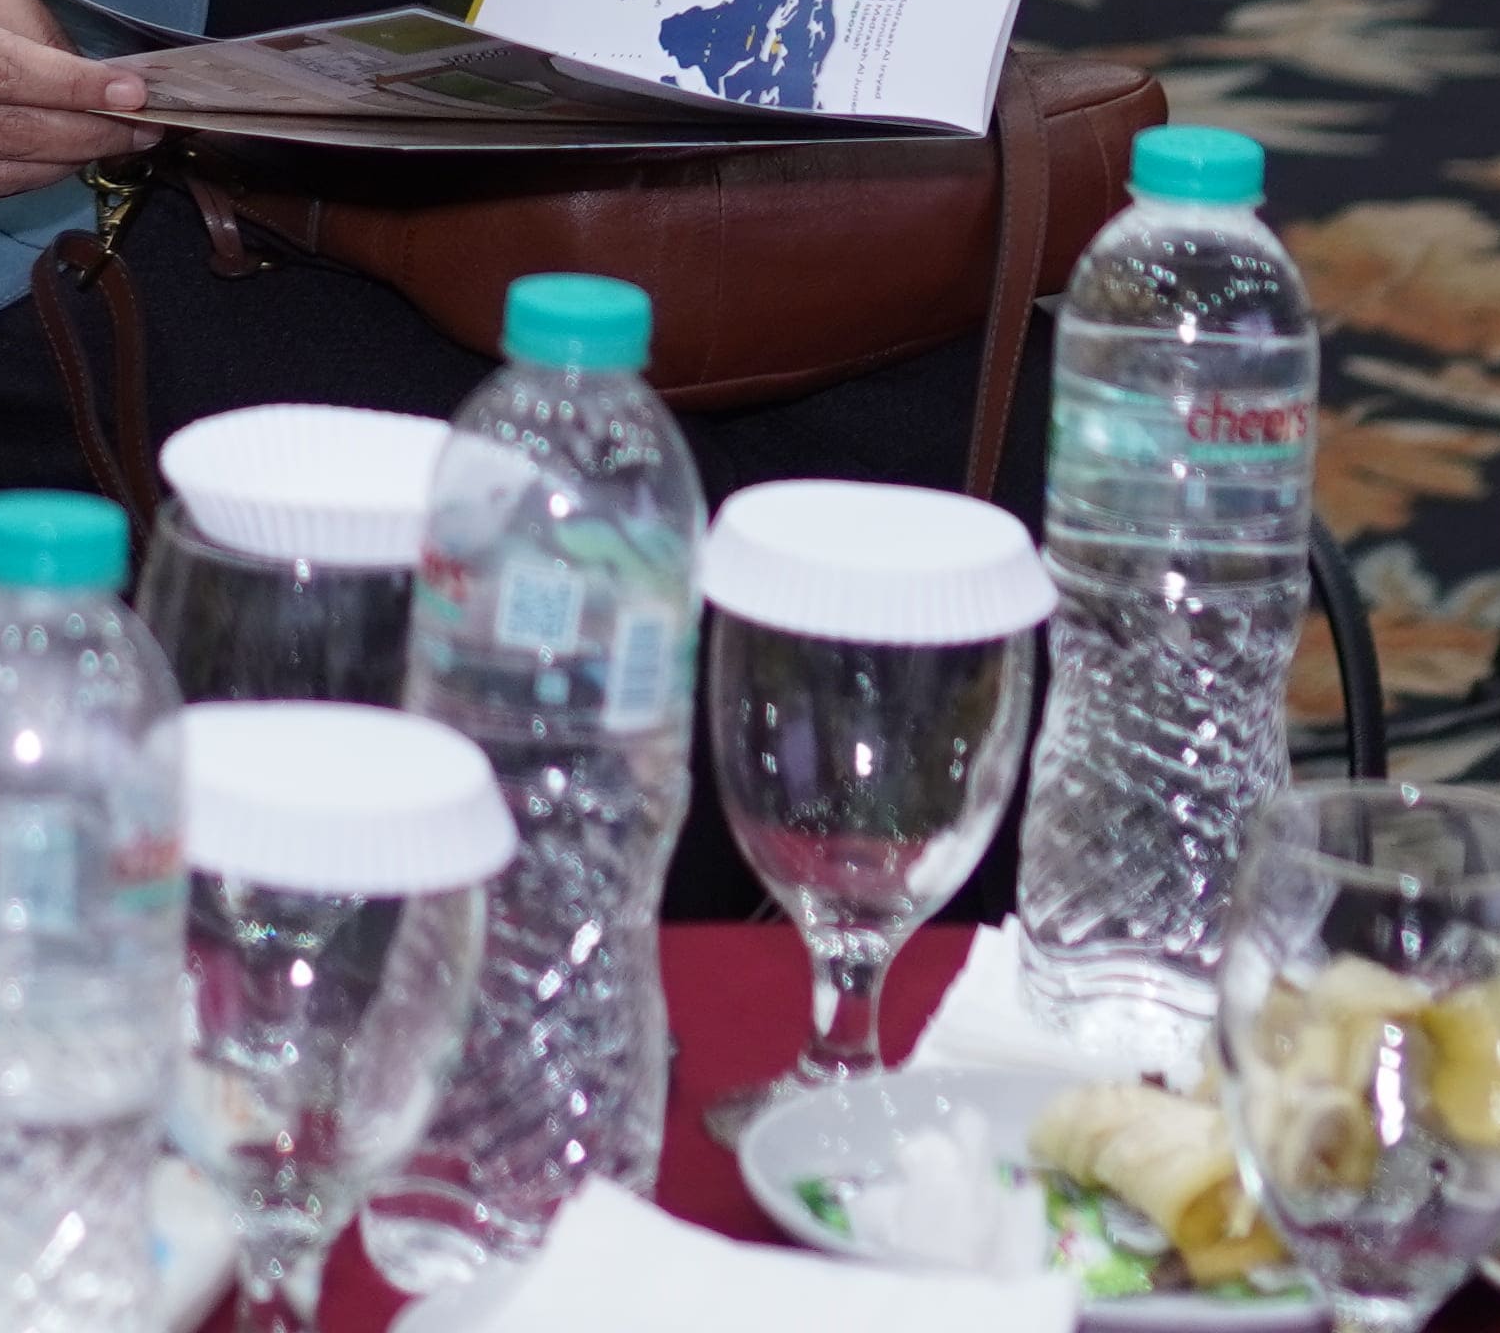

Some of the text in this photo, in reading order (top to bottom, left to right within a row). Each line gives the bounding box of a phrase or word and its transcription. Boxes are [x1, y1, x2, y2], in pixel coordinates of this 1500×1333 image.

[852, 4, 873, 50] Islamiah
[860, 4, 883, 62] Madrasah
[874, 4, 894, 51] Islamiah
[857, 63, 866, 75] Al
[882, 49, 892, 61] Al
[874, 64, 888, 101] Irsyad
[1185, 393, 1309, 443] cheers
